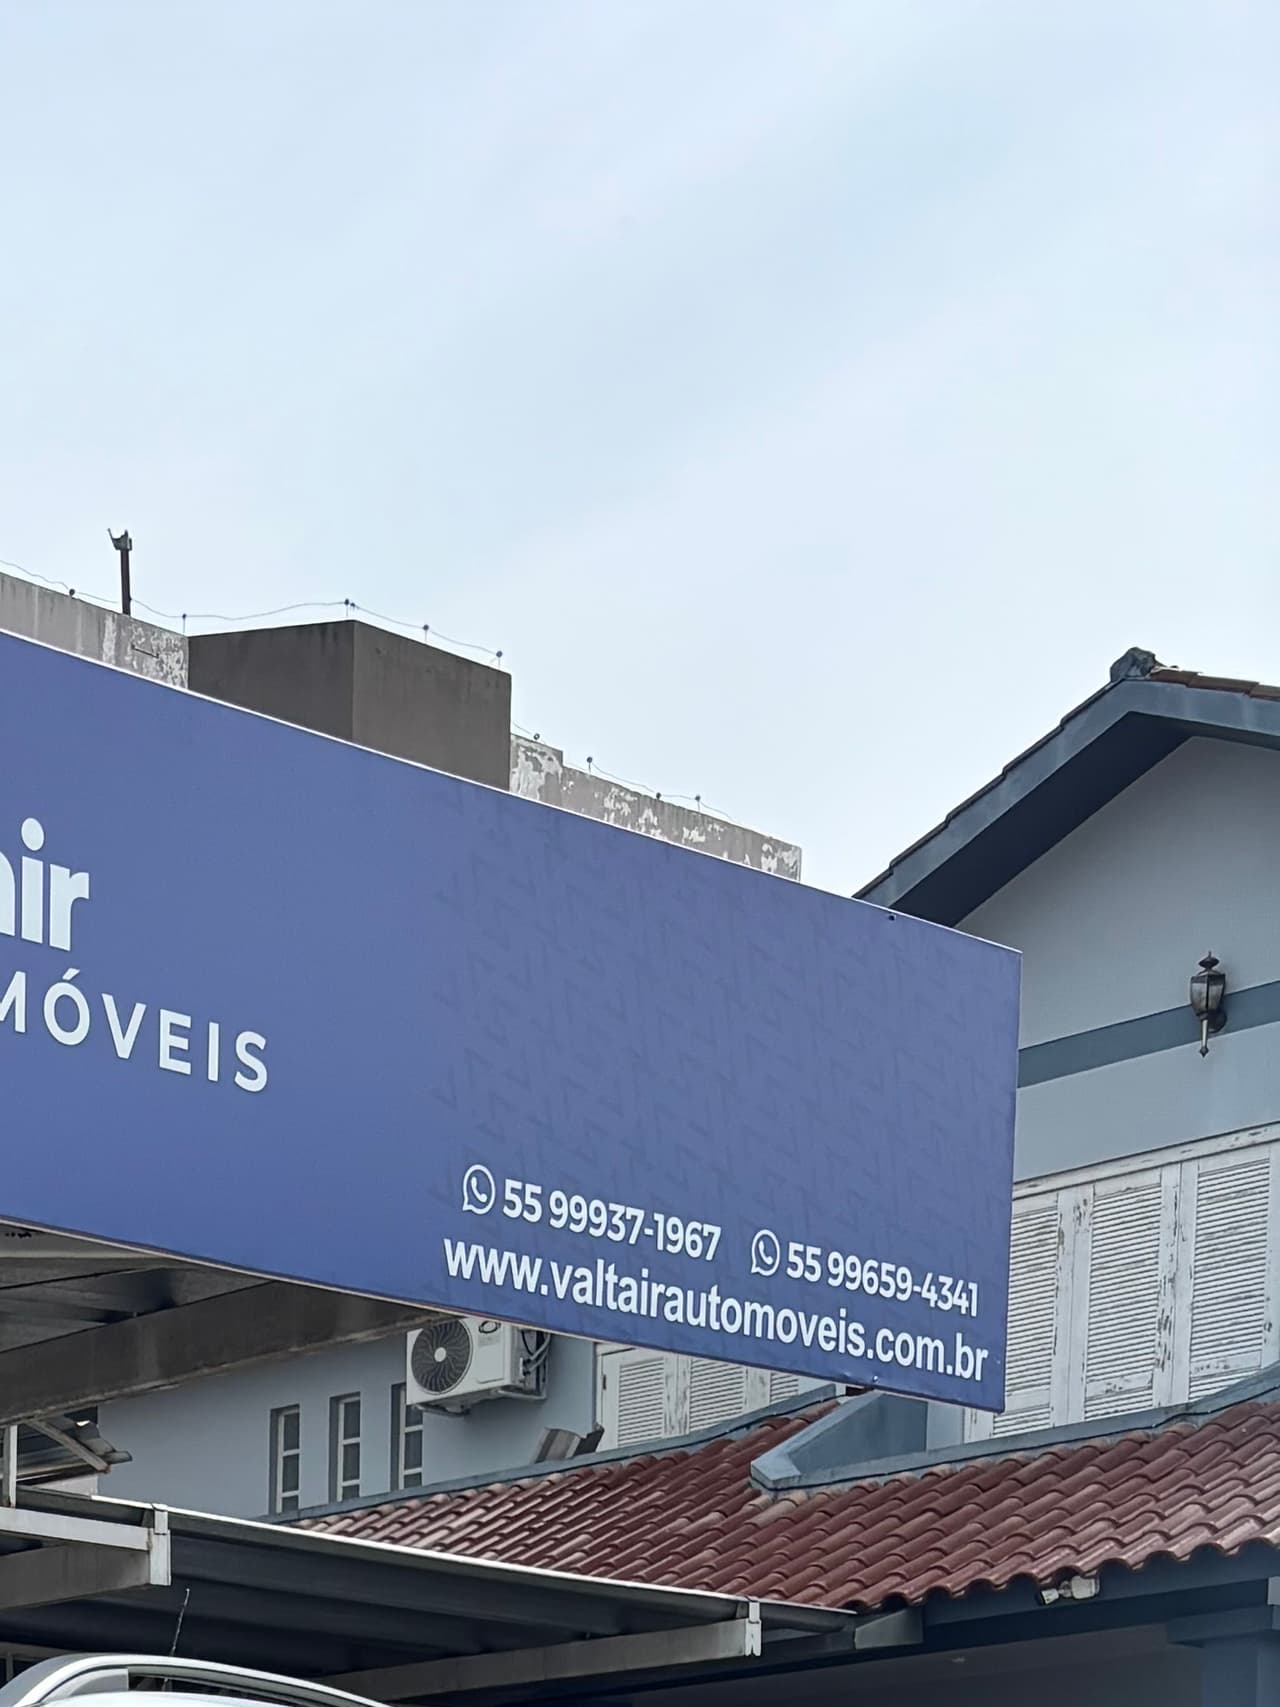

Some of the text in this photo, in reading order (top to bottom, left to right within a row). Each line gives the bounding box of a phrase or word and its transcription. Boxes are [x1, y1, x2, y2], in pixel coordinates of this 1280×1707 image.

[503, 1178, 722, 1261] 55 99937-1967
[443, 1236, 989, 1381] www.valtairautomoveis.com.br
[786, 1241, 978, 1317] 55 99659-4341
